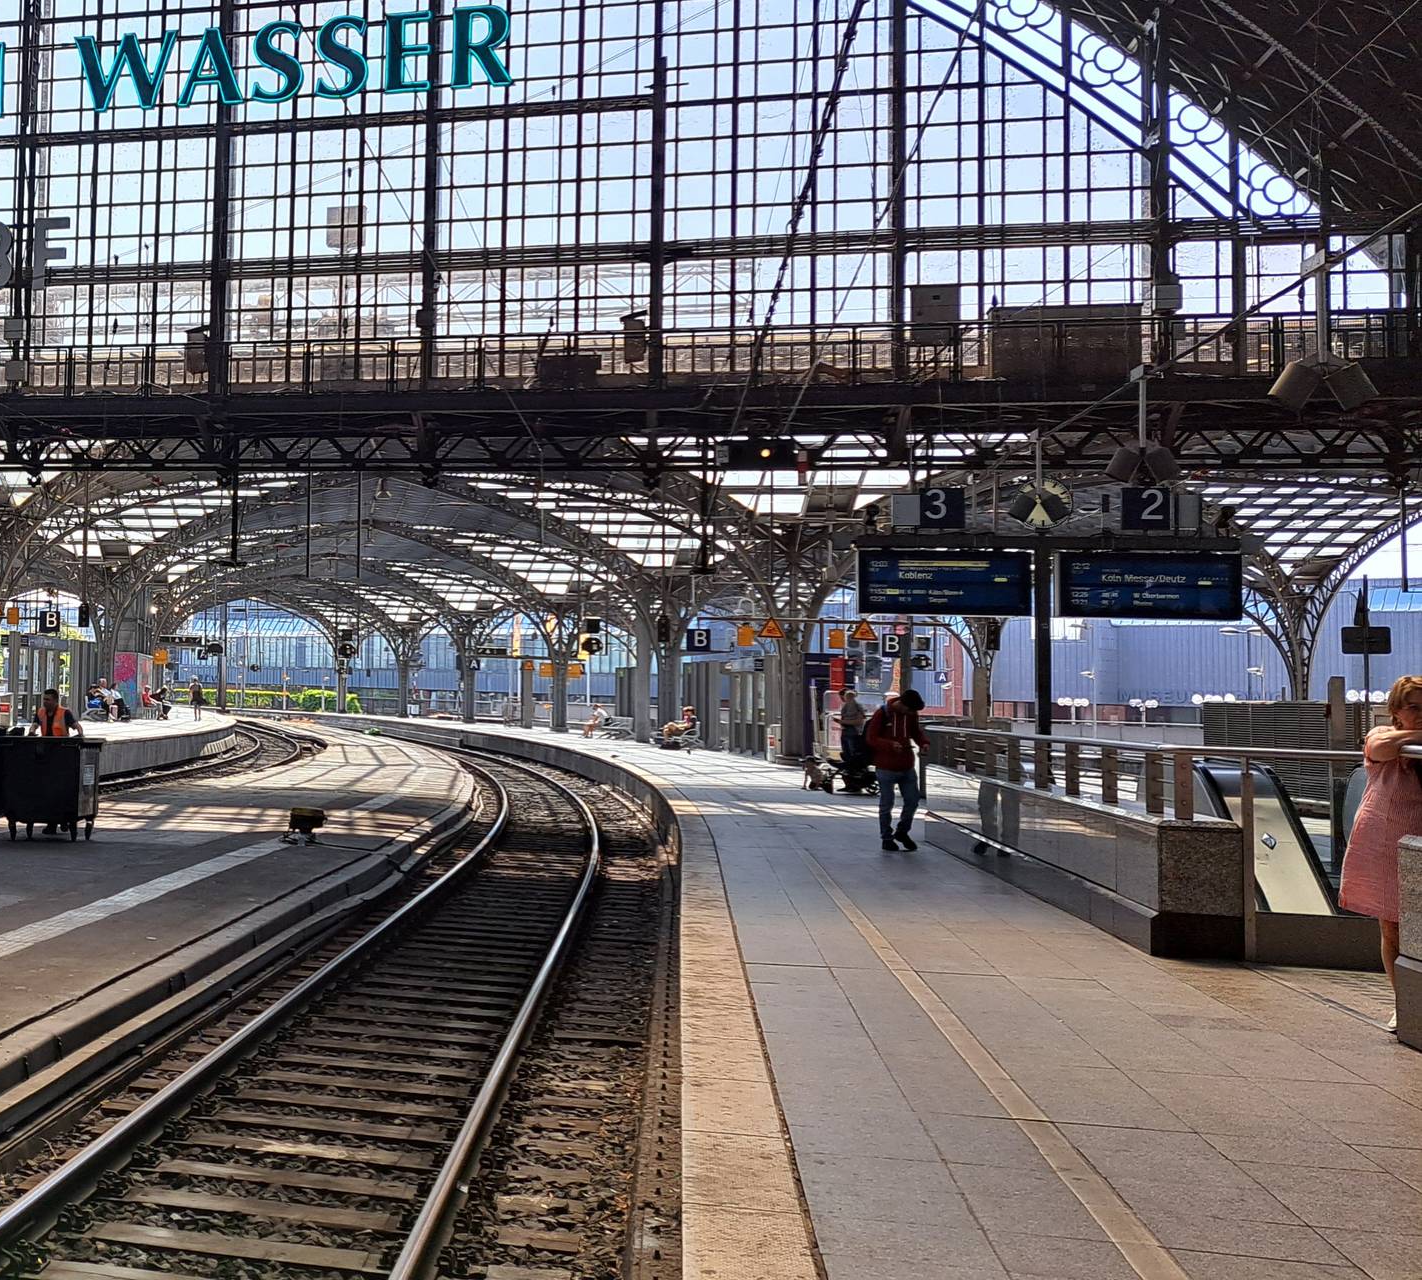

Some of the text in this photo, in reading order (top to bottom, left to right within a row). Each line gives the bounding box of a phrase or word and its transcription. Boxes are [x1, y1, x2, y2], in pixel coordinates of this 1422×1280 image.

[73, 4, 516, 113] WASSER
[924, 489, 948, 519] 3
[1140, 489, 1164, 520] 2
[898, 571, 934, 580] Koblenz
[1124, 574, 1187, 583] Messe/Deutz
[46, 612, 57, 628] B
[693, 631, 707, 647] B
[885, 635, 899, 652] B
[469, 661, 478, 670] A
[938, 672, 947, 682] A
